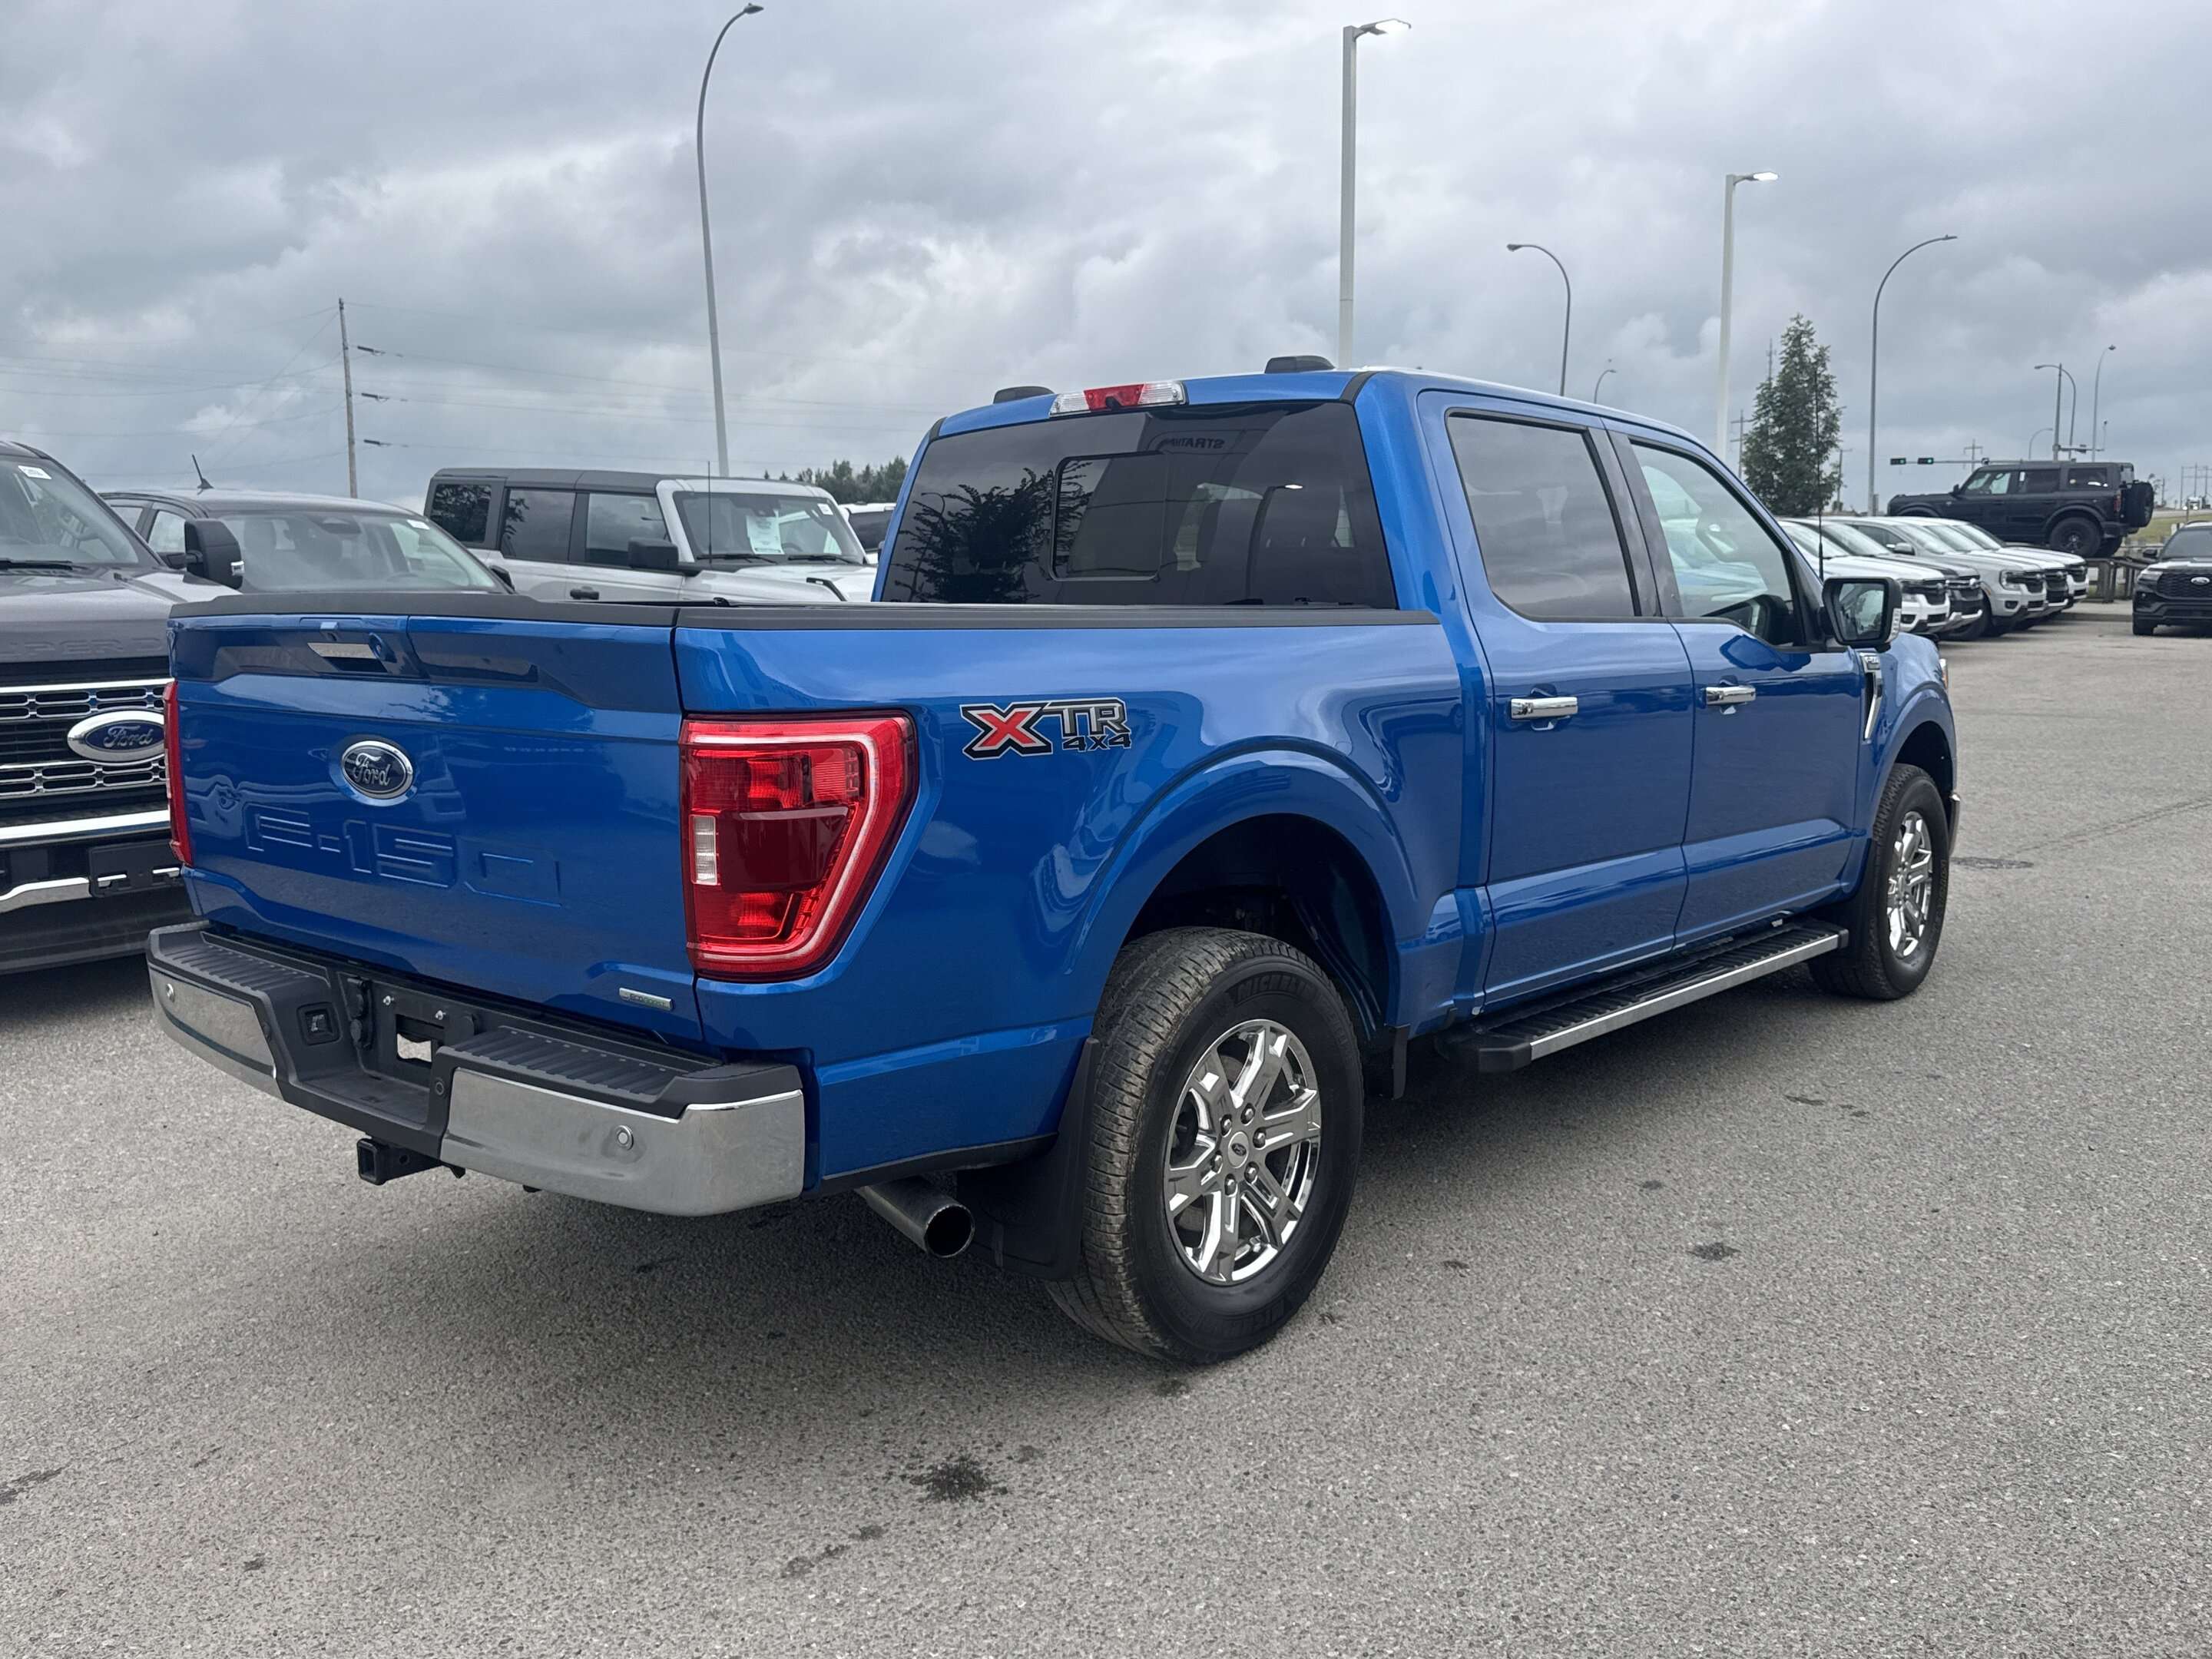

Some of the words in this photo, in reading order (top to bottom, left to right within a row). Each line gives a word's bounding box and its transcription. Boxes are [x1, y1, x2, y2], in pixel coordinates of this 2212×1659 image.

[103, 724, 154, 748] Ford
[960, 697, 1131, 761] XTR
[353, 752, 392, 786] Ford
